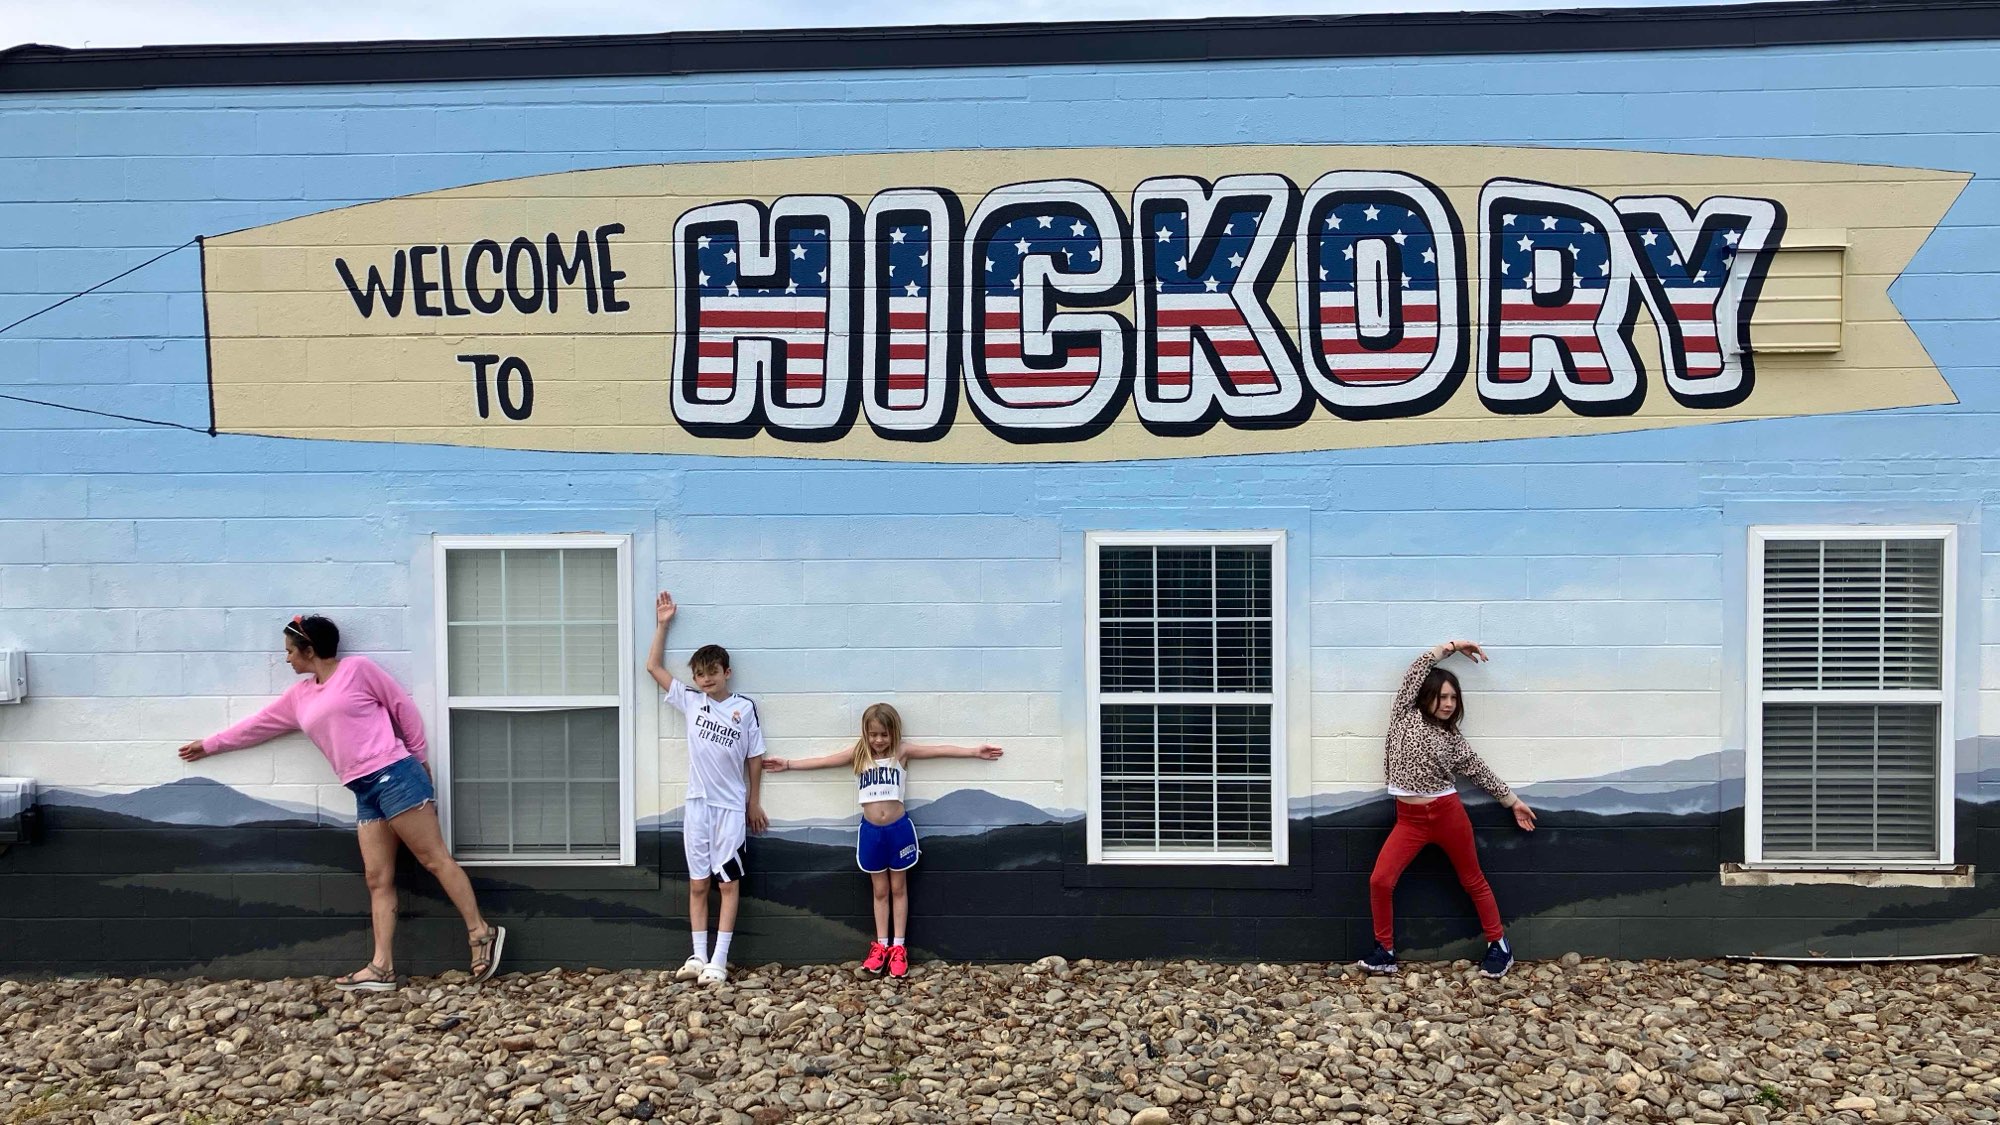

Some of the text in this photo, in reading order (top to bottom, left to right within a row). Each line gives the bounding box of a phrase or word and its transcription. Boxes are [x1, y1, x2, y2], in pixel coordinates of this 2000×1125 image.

[335, 223, 630, 318] WELCOME
[671, 170, 1785, 444] HICKORY
[456, 354, 534, 421] TO
[695, 714, 741, 741] Emirates
[698, 729, 734, 748] FLY BETTER
